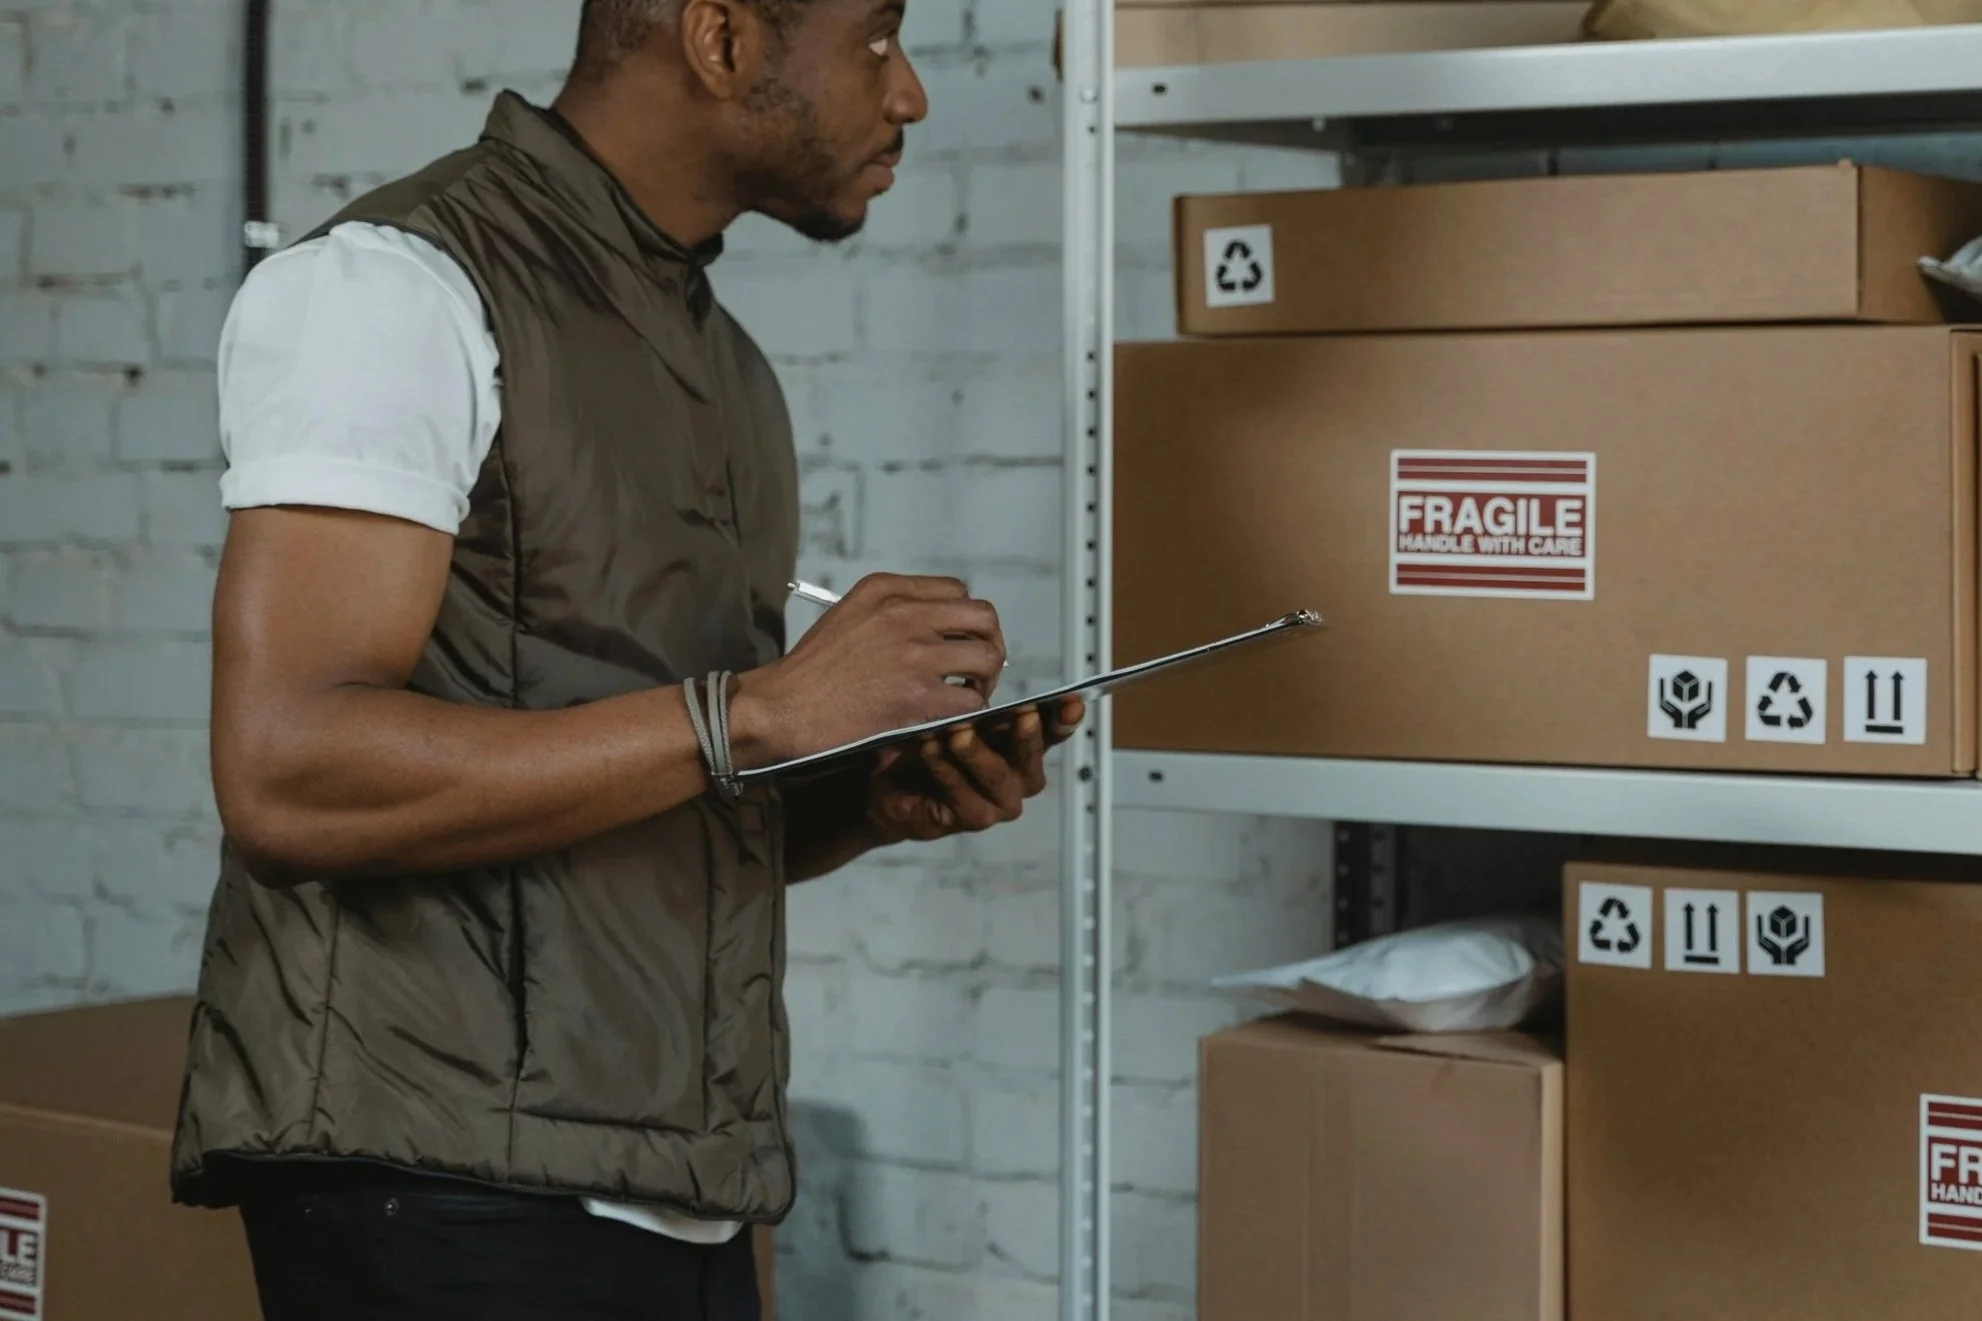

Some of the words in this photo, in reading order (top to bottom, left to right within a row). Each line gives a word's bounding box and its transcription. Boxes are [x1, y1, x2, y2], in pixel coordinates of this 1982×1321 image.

[1399, 495, 1583, 537] FRAGILE
[1399, 533, 1475, 553] HANDLE
[1478, 535, 1525, 555] WITH
[1528, 537, 1582, 556] CARE
[1931, 1143, 1982, 1185] FR
[0, 1230, 35, 1265] LE
